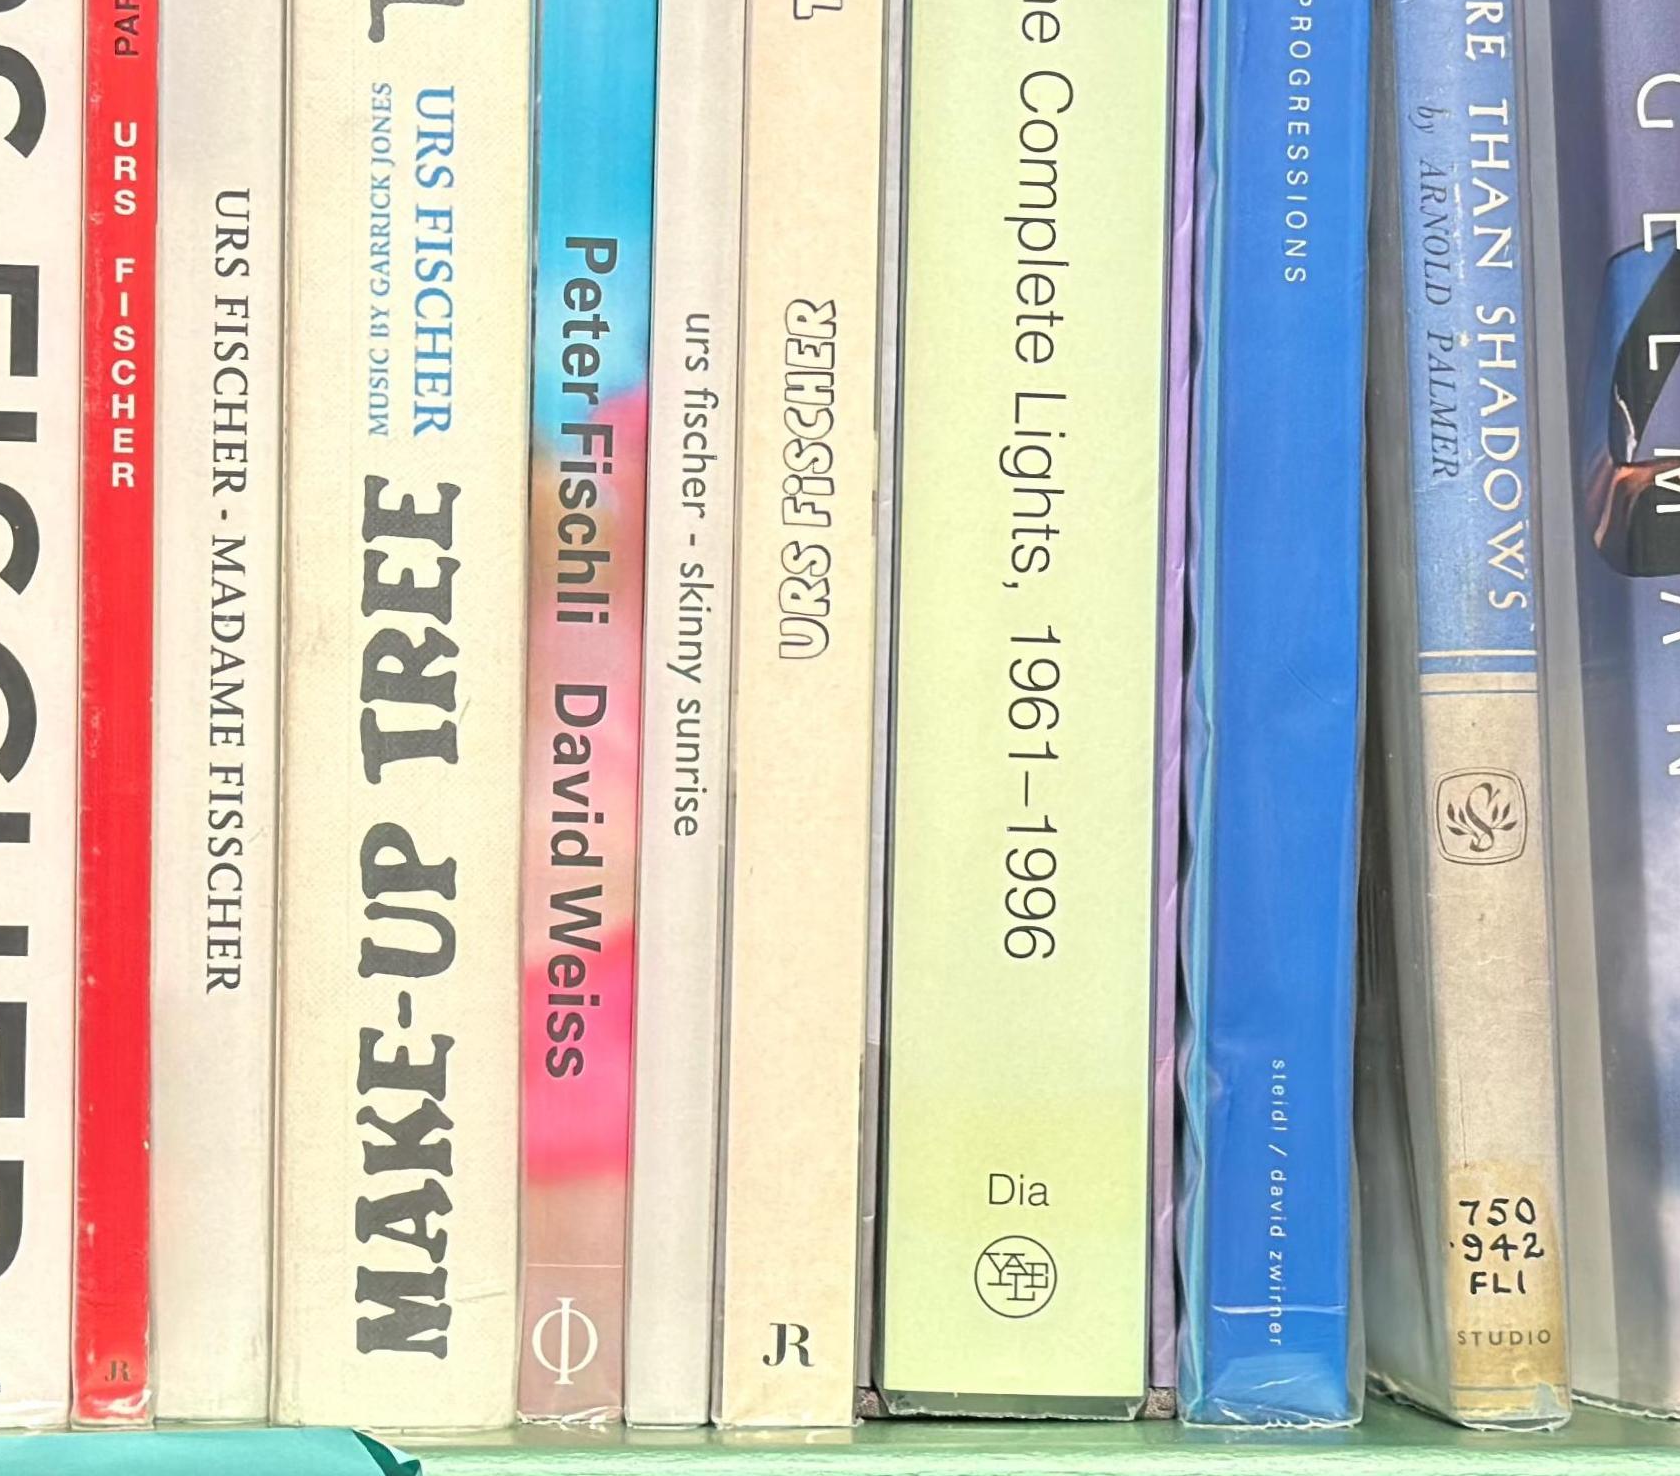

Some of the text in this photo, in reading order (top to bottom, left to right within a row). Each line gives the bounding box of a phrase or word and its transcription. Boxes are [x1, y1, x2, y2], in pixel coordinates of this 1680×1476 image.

[111, 122, 137, 488] URS FISCHER
[367, 81, 396, 437] MUSIC BY GARRICK JONES
[414, 86, 454, 436] URS FISCHER
[1004, 71, 1073, 363] Complete
[1415, 104, 1459, 477] by ARNOLD PALMER
[1469, 99, 1512, 268] THAN
[207, 189, 249, 994] URS FISCHER MADAME FISSCHER
[667, 314, 721, 836] urs fischer skinny sunrise
[999, 393, 1066, 588] Lights,
[1475, 302, 1530, 611] SHADOWS
[545, 237, 617, 1079] Peter Fischli David Weiss
[355, 822, 456, 1359] MAKE-UP
[989, 1174, 1049, 1206] Dia
[1269, 1060, 1288, 1344] steidl david zwirner
[1459, 1197, 1536, 1226] 750
[1458, 1328, 1551, 1346] STUDIO
